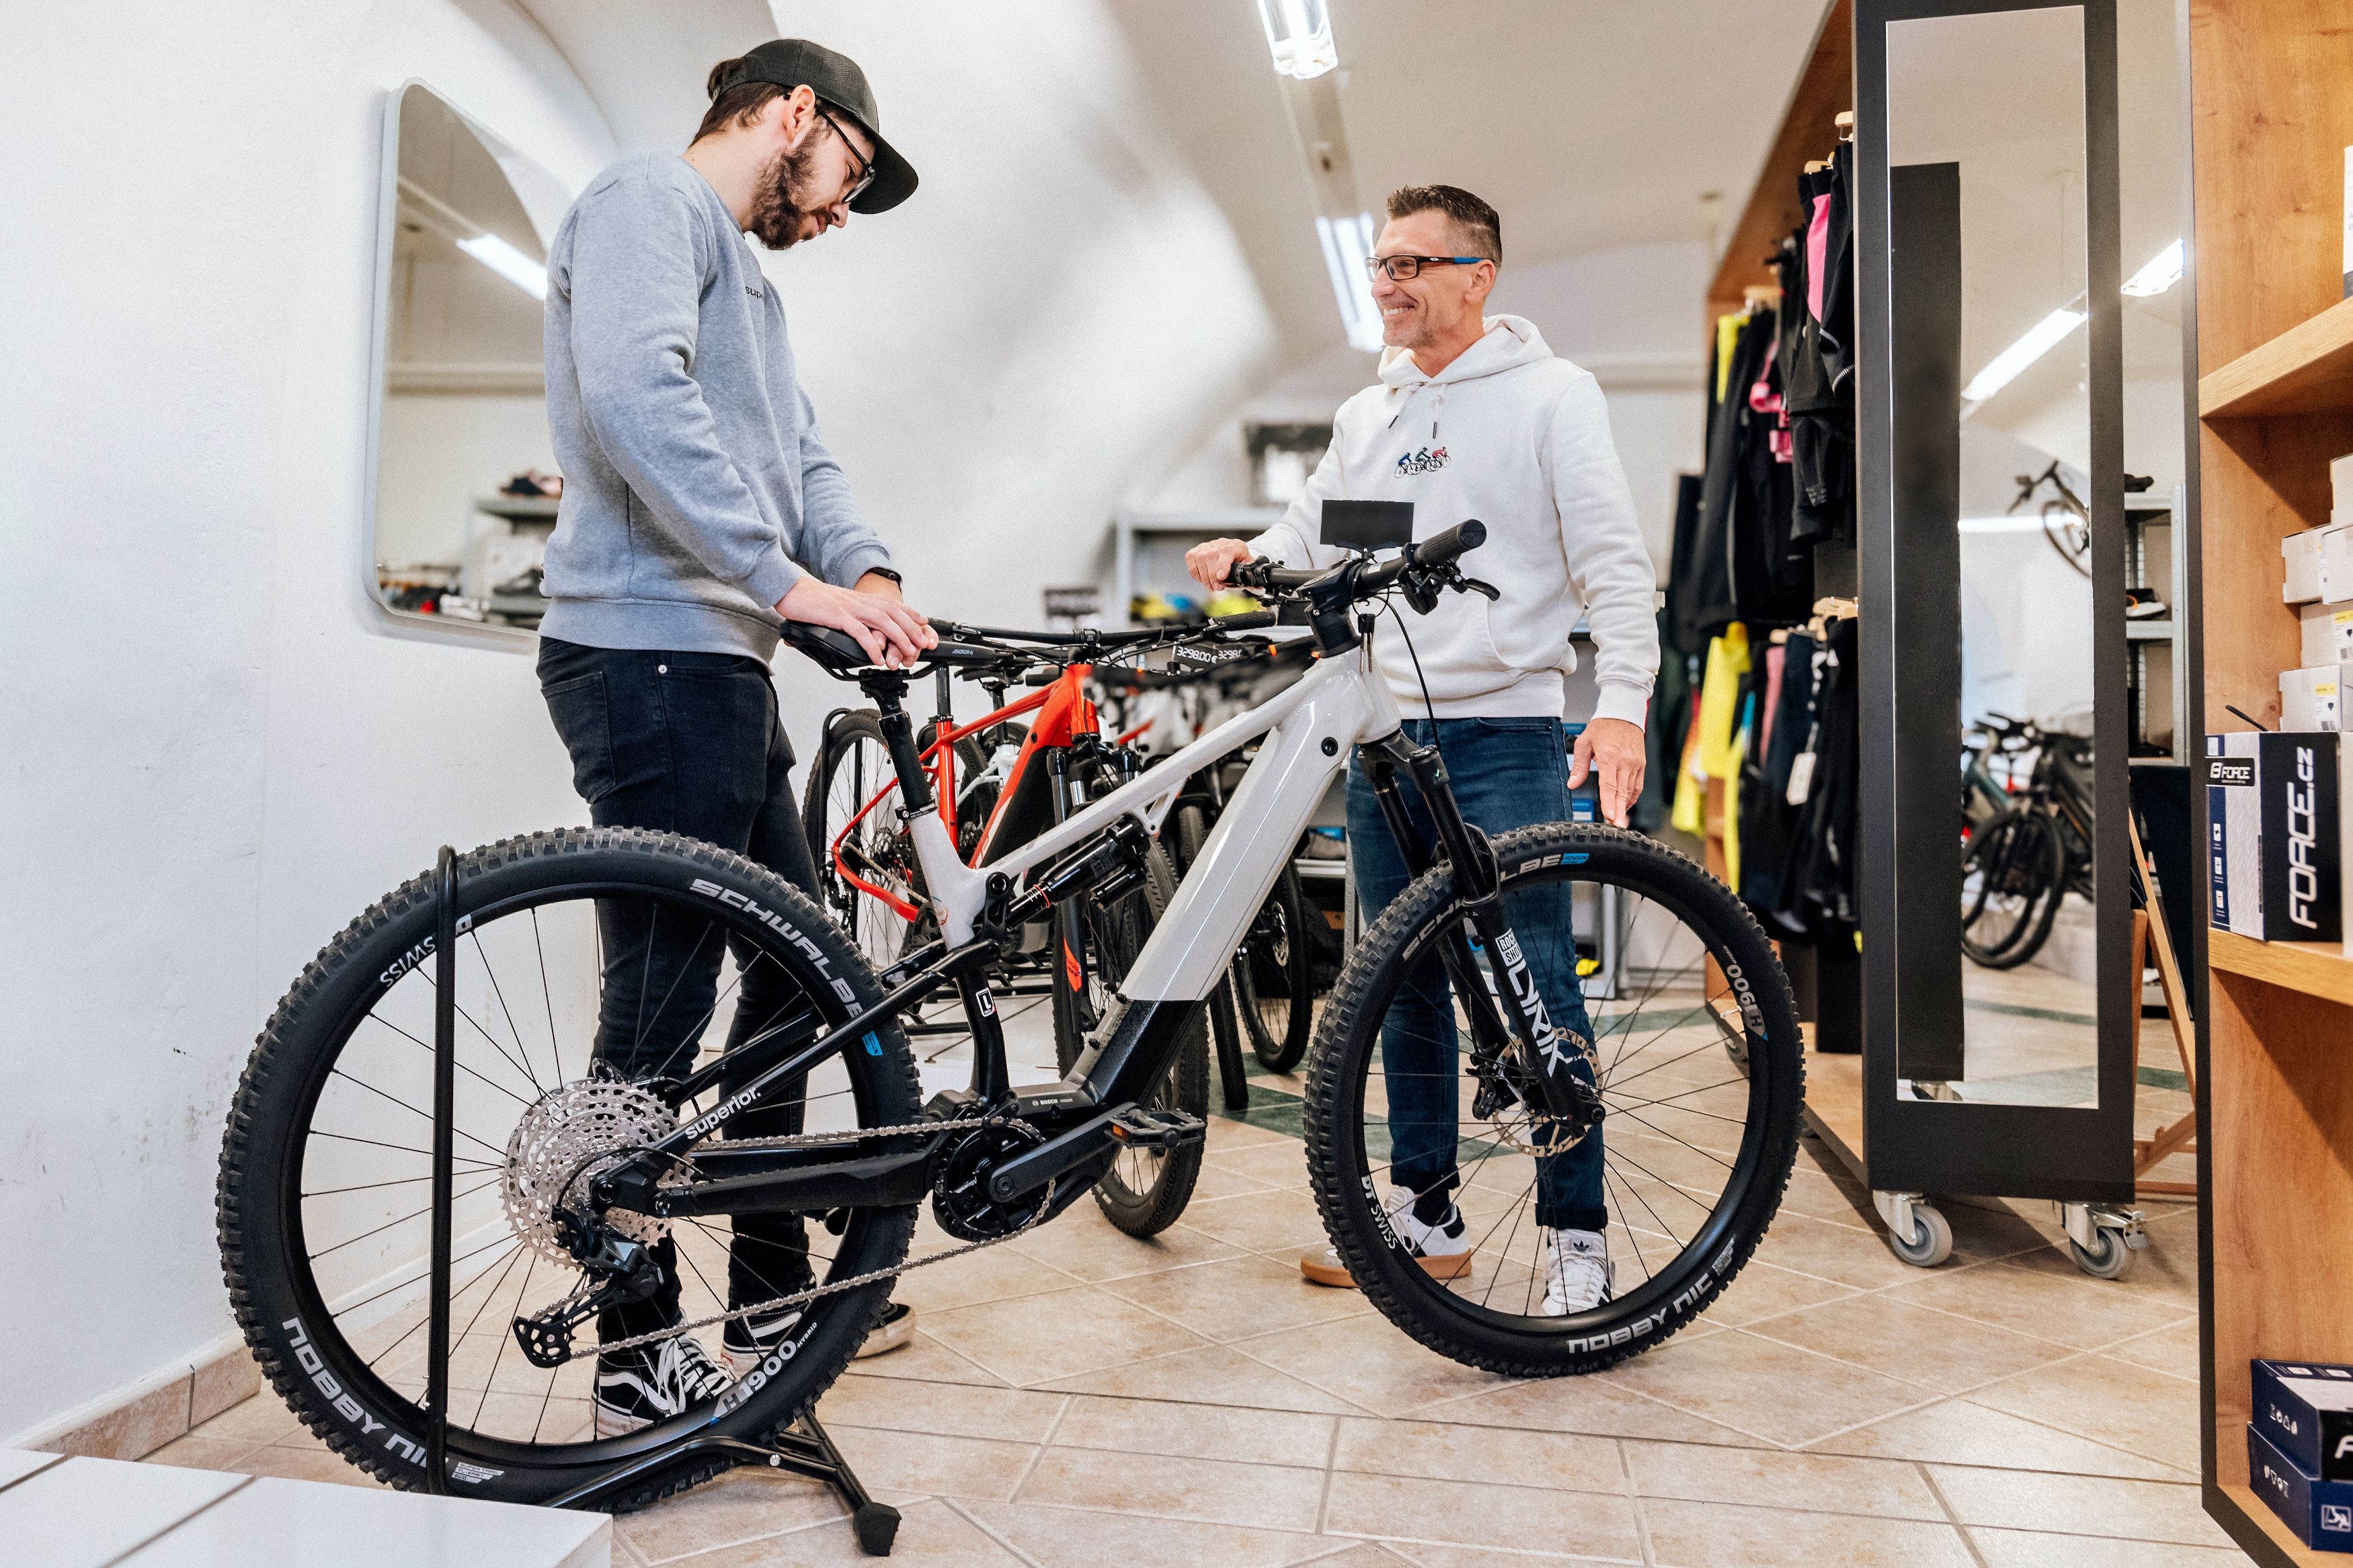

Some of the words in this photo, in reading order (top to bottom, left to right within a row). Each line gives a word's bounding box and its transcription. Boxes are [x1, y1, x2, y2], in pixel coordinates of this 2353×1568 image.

[2286, 746, 2319, 930] FORCE.cz
[380, 936, 436, 987] SWISS
[689, 878, 864, 1018] SCHWALBE
[1361, 1174, 1376, 1200] DT
[1370, 1204, 1398, 1249] SWISS
[797, 1322, 817, 1348] HYBRID
